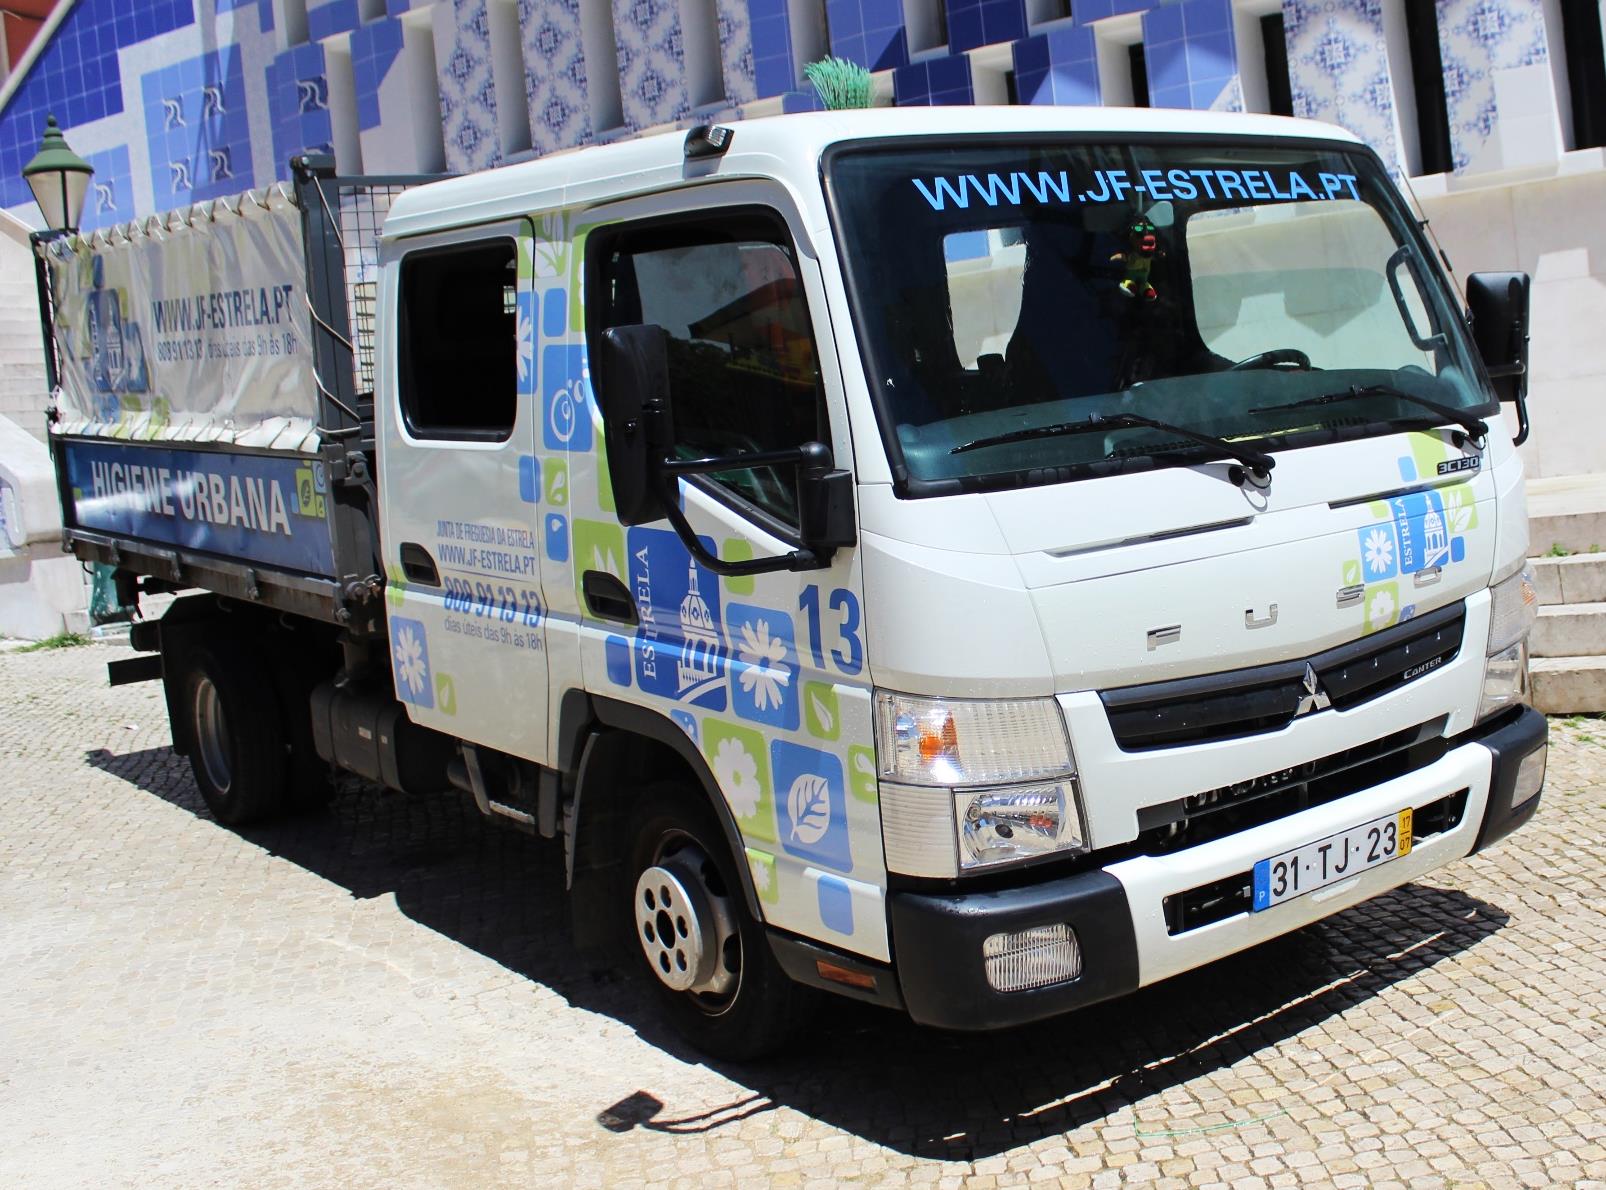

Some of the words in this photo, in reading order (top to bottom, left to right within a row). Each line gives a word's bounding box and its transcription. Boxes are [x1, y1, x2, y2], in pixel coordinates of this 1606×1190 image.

[911, 169, 1362, 211] WWW.JF-ESTRELA.PT
[152, 284, 293, 333] WWW.JF-ESTRELA.PT
[282, 331, 298, 355] 18h
[1437, 456, 1479, 474] 3C130
[91, 460, 175, 516] HIGIENE
[176, 469, 292, 536] URBANA
[436, 519, 455, 538] JUNTA
[455, 522, 464, 540] DE
[464, 523, 496, 545] FREGUESIA
[497, 527, 507, 546] DA
[507, 528, 535, 550] ESTRELA
[1394, 498, 1413, 566] ESTRELA
[437, 543, 536, 576] WWW.JF-ESTRELA.PT
[475, 582, 495, 619] 91
[497, 585, 518, 624] 13
[521, 589, 542, 628] 13
[635, 546, 658, 681] ESTRELA
[444, 615, 462, 633] dias
[483, 622, 500, 642] das
[500, 626, 512, 645] 9h
[526, 632, 543, 652] 18h
[798, 584, 864, 676] 13
[1403, 656, 1442, 680] CANTER
[1402, 815, 1411, 829] 17
[1400, 837, 1411, 851] 07
[1258, 890, 1266, 903] P
